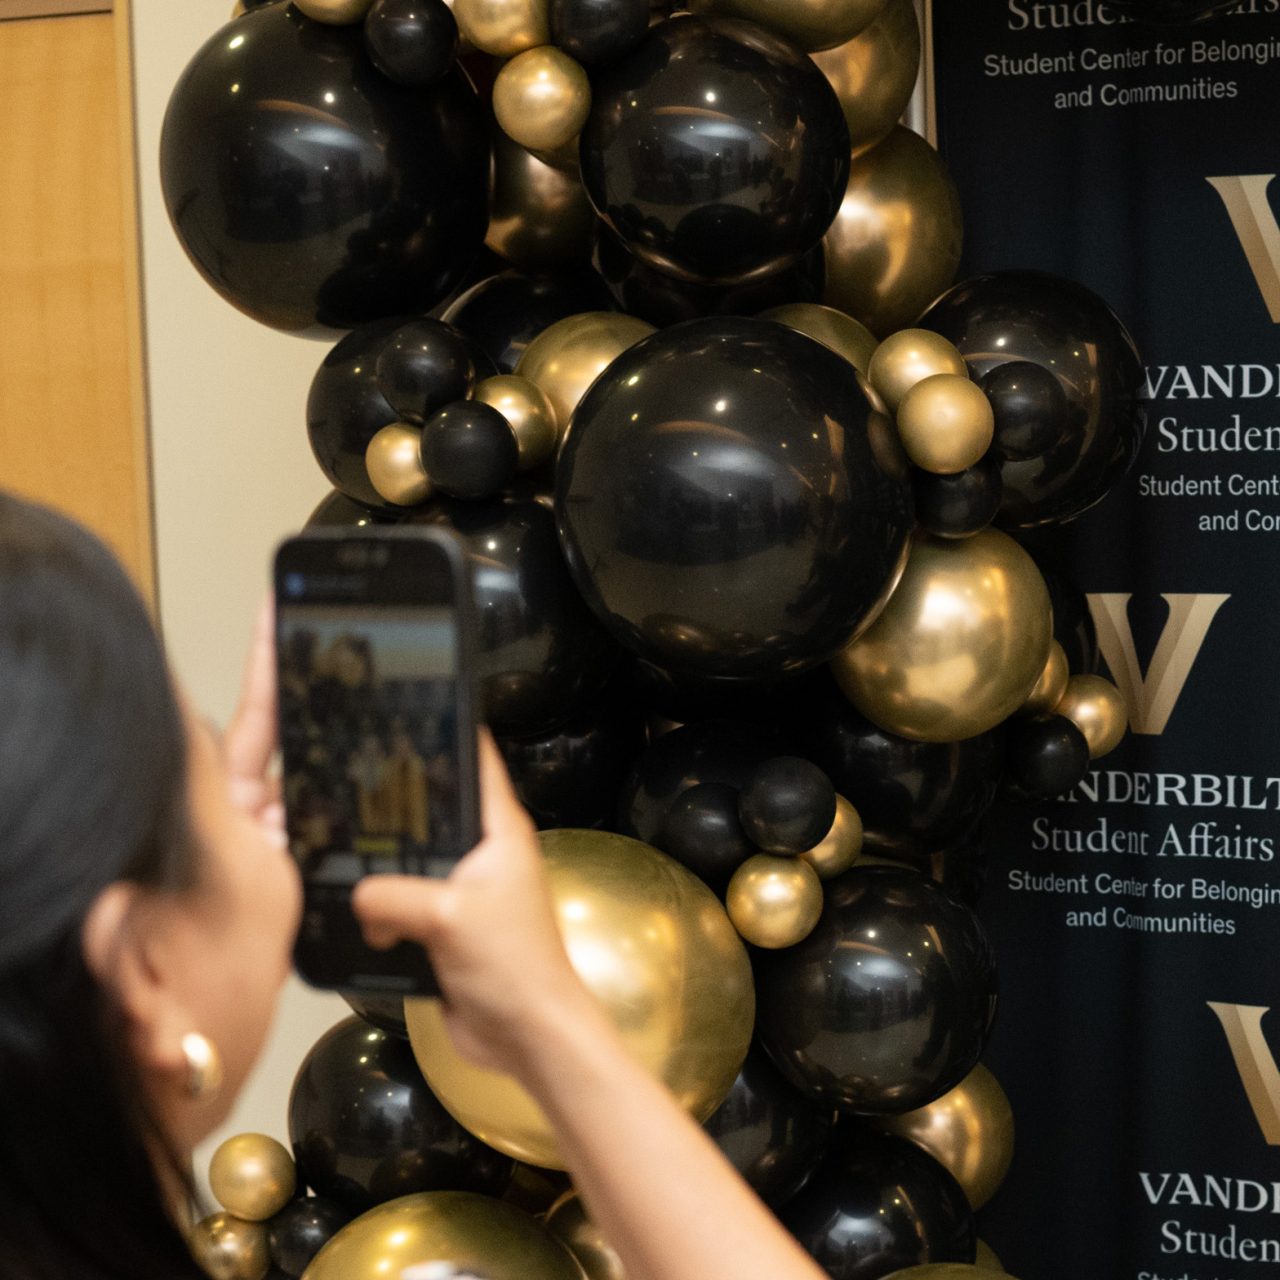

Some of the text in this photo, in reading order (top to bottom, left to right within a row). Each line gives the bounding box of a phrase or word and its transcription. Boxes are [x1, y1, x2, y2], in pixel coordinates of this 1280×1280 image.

[984, 54, 1075, 77] Student
[1080, 48, 1150, 71] Center
[1154, 43, 1186, 65] for
[1054, 76, 1239, 109] and Communities
[1139, 474, 1222, 496] Student
[1198, 509, 1239, 532] and
[1032, 817, 1274, 862] Student Affairs
[1008, 870, 1088, 894] Student
[1095, 873, 1148, 897] Center
[1152, 878, 1185, 900] for
[1066, 907, 1236, 935] and Communities
